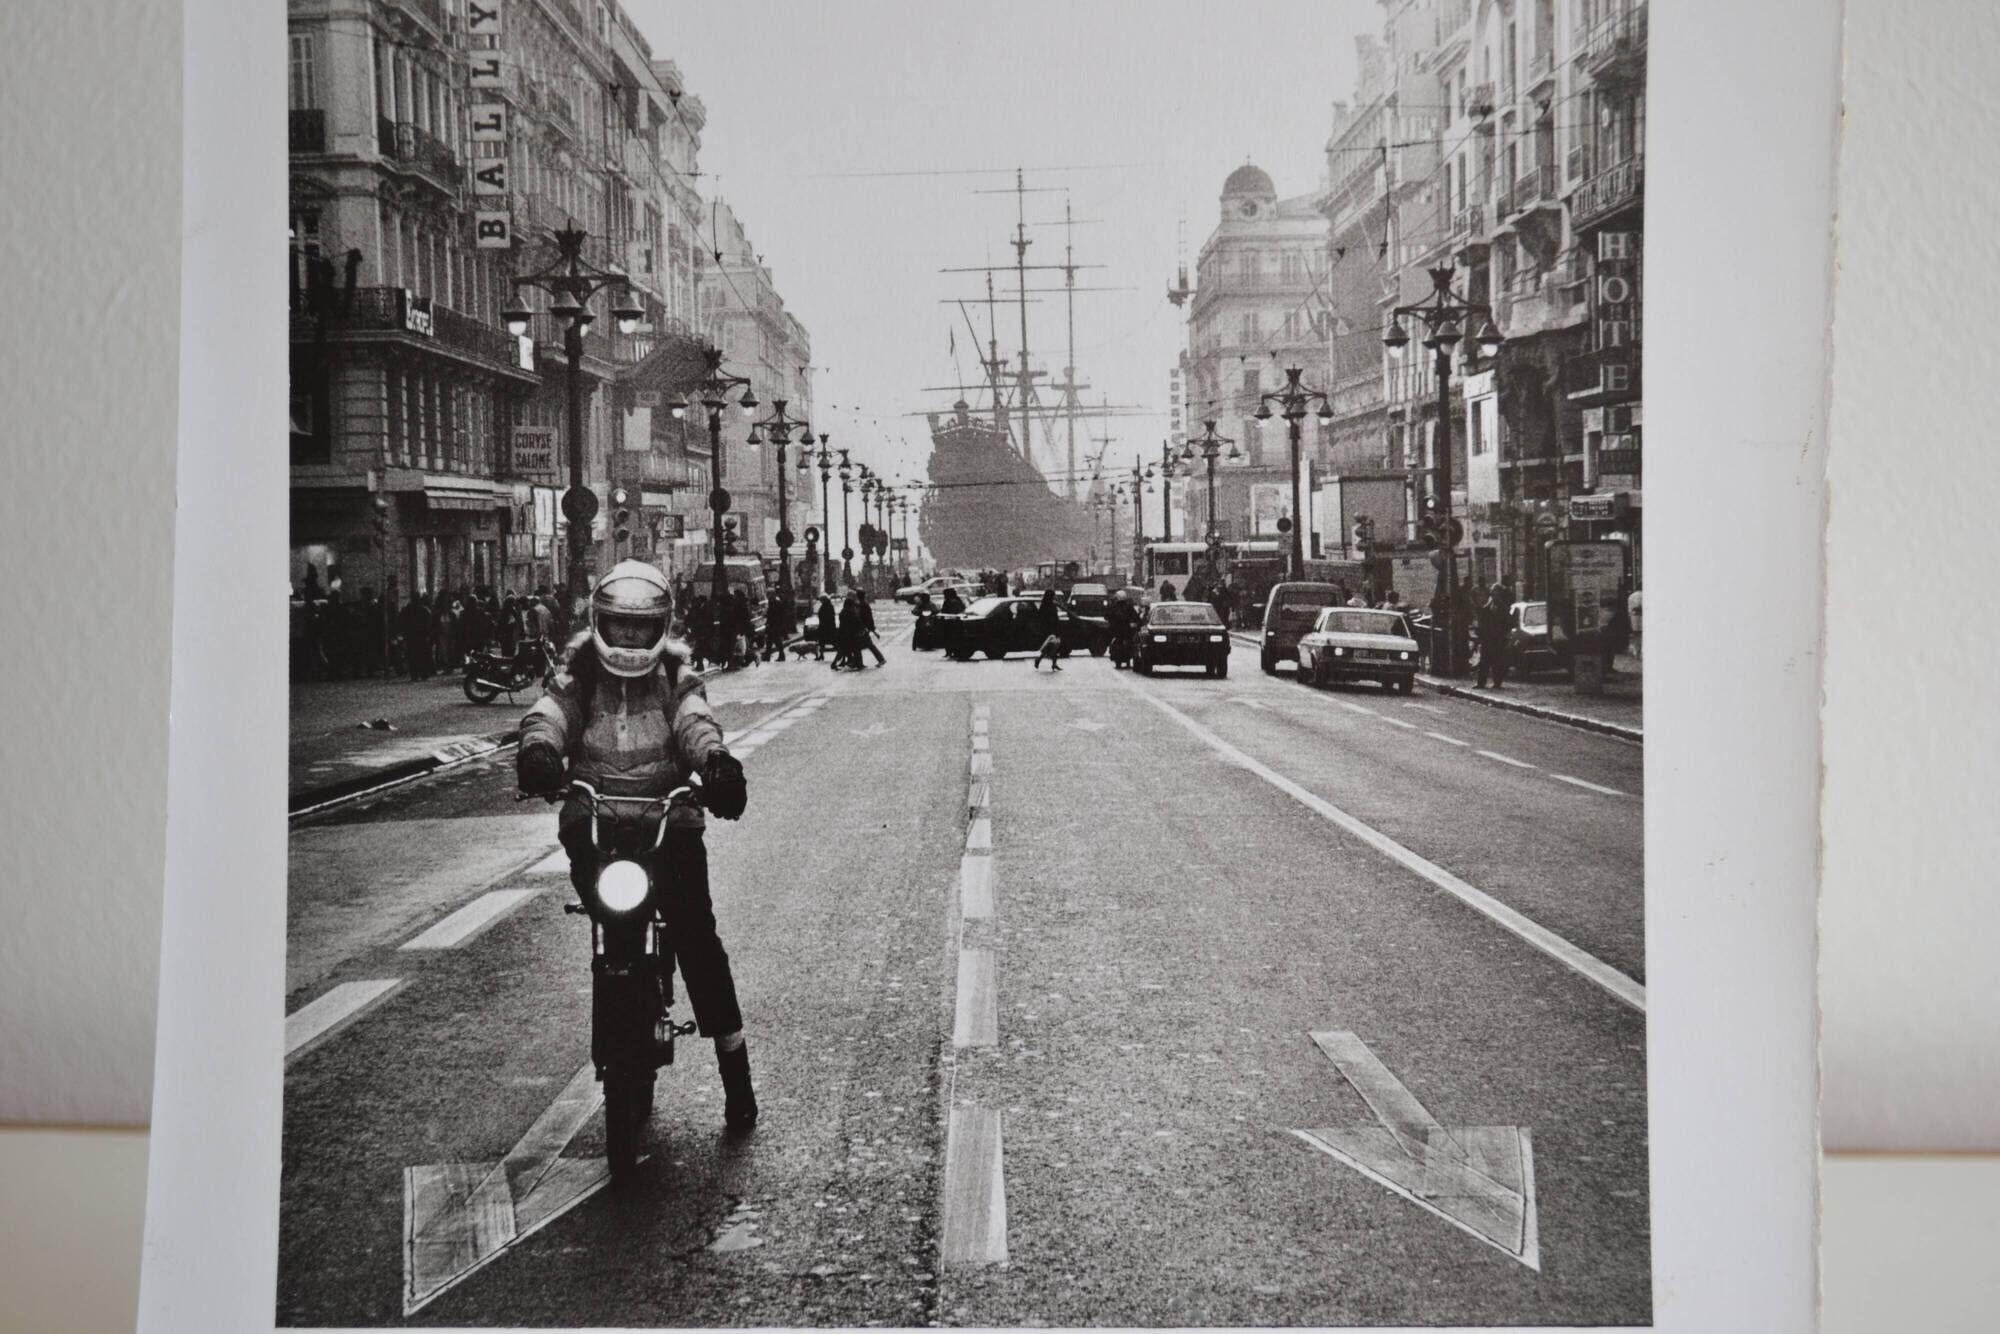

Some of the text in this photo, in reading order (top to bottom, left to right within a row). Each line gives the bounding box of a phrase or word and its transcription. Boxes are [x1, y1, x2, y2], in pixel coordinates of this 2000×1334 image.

[470, 2, 505, 239] BALLY
[1602, 232, 1629, 433] HOTEL
[515, 432, 552, 449] CORYSE
